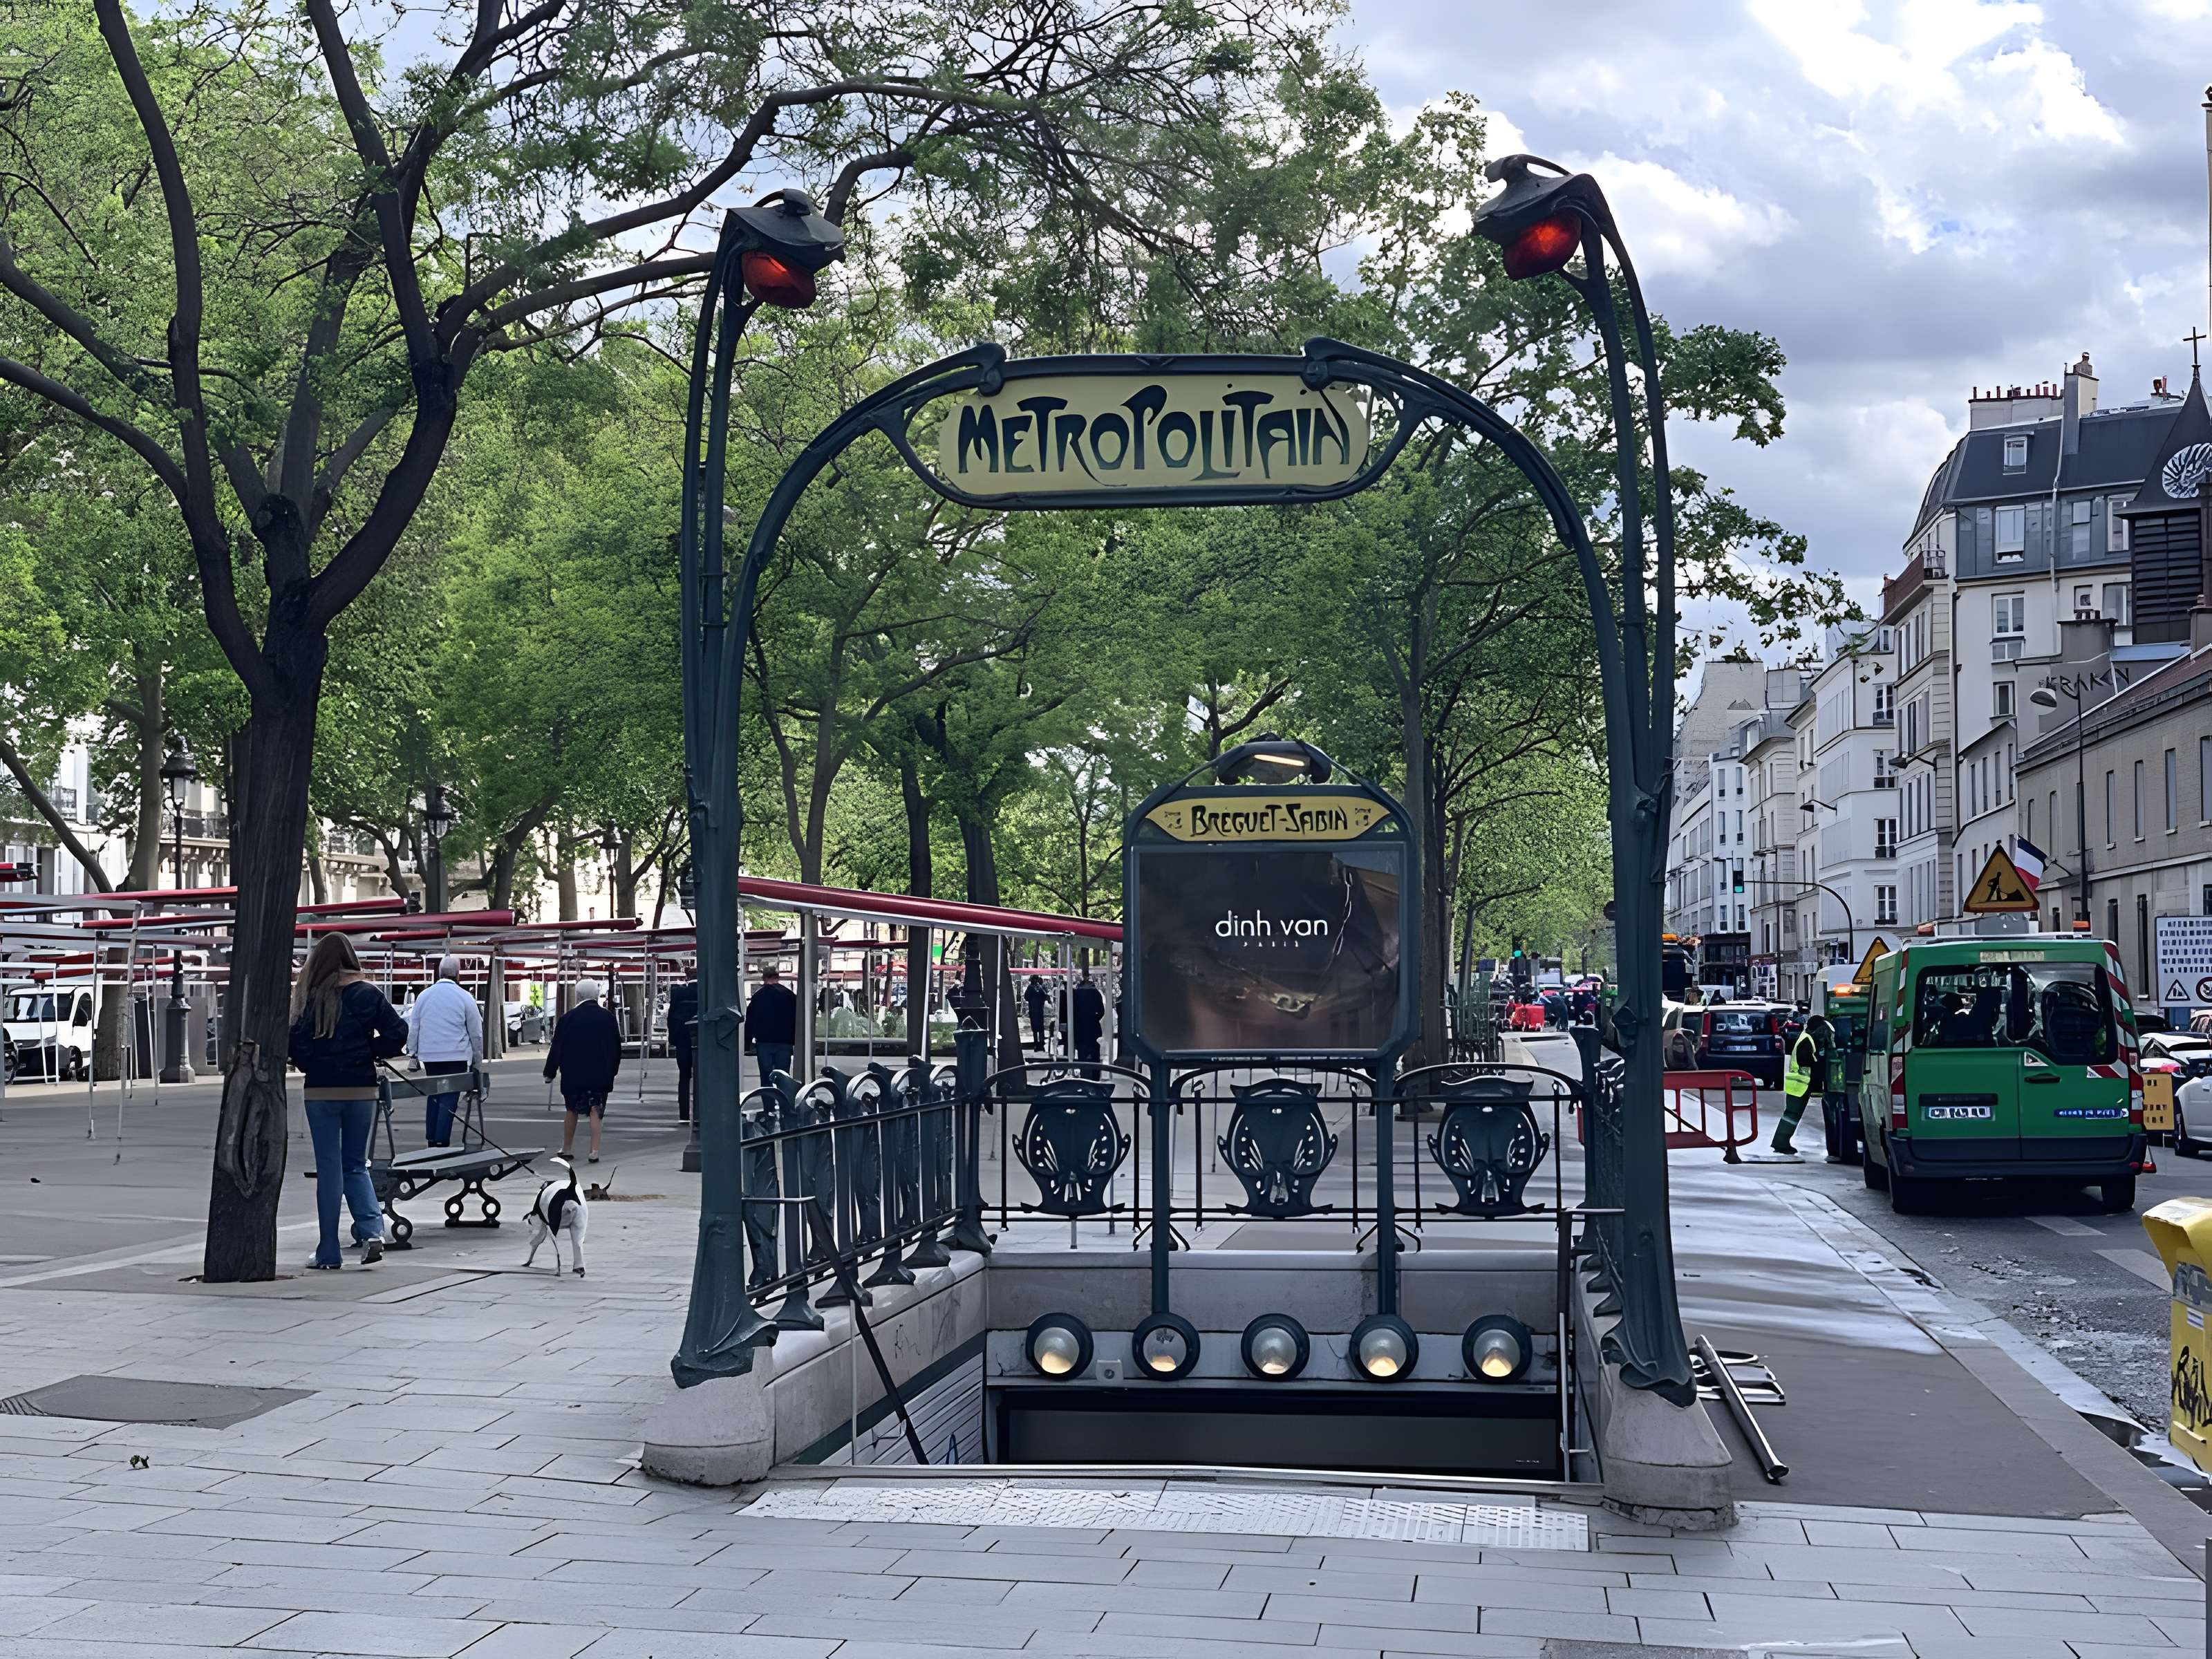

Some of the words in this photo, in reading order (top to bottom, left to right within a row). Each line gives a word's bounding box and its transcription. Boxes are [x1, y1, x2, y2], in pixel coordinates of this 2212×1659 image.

[958, 384, 1350, 486] METROPOLITAIN
[1215, 909, 1271, 937] dinh
[1280, 919, 1328, 936] van
